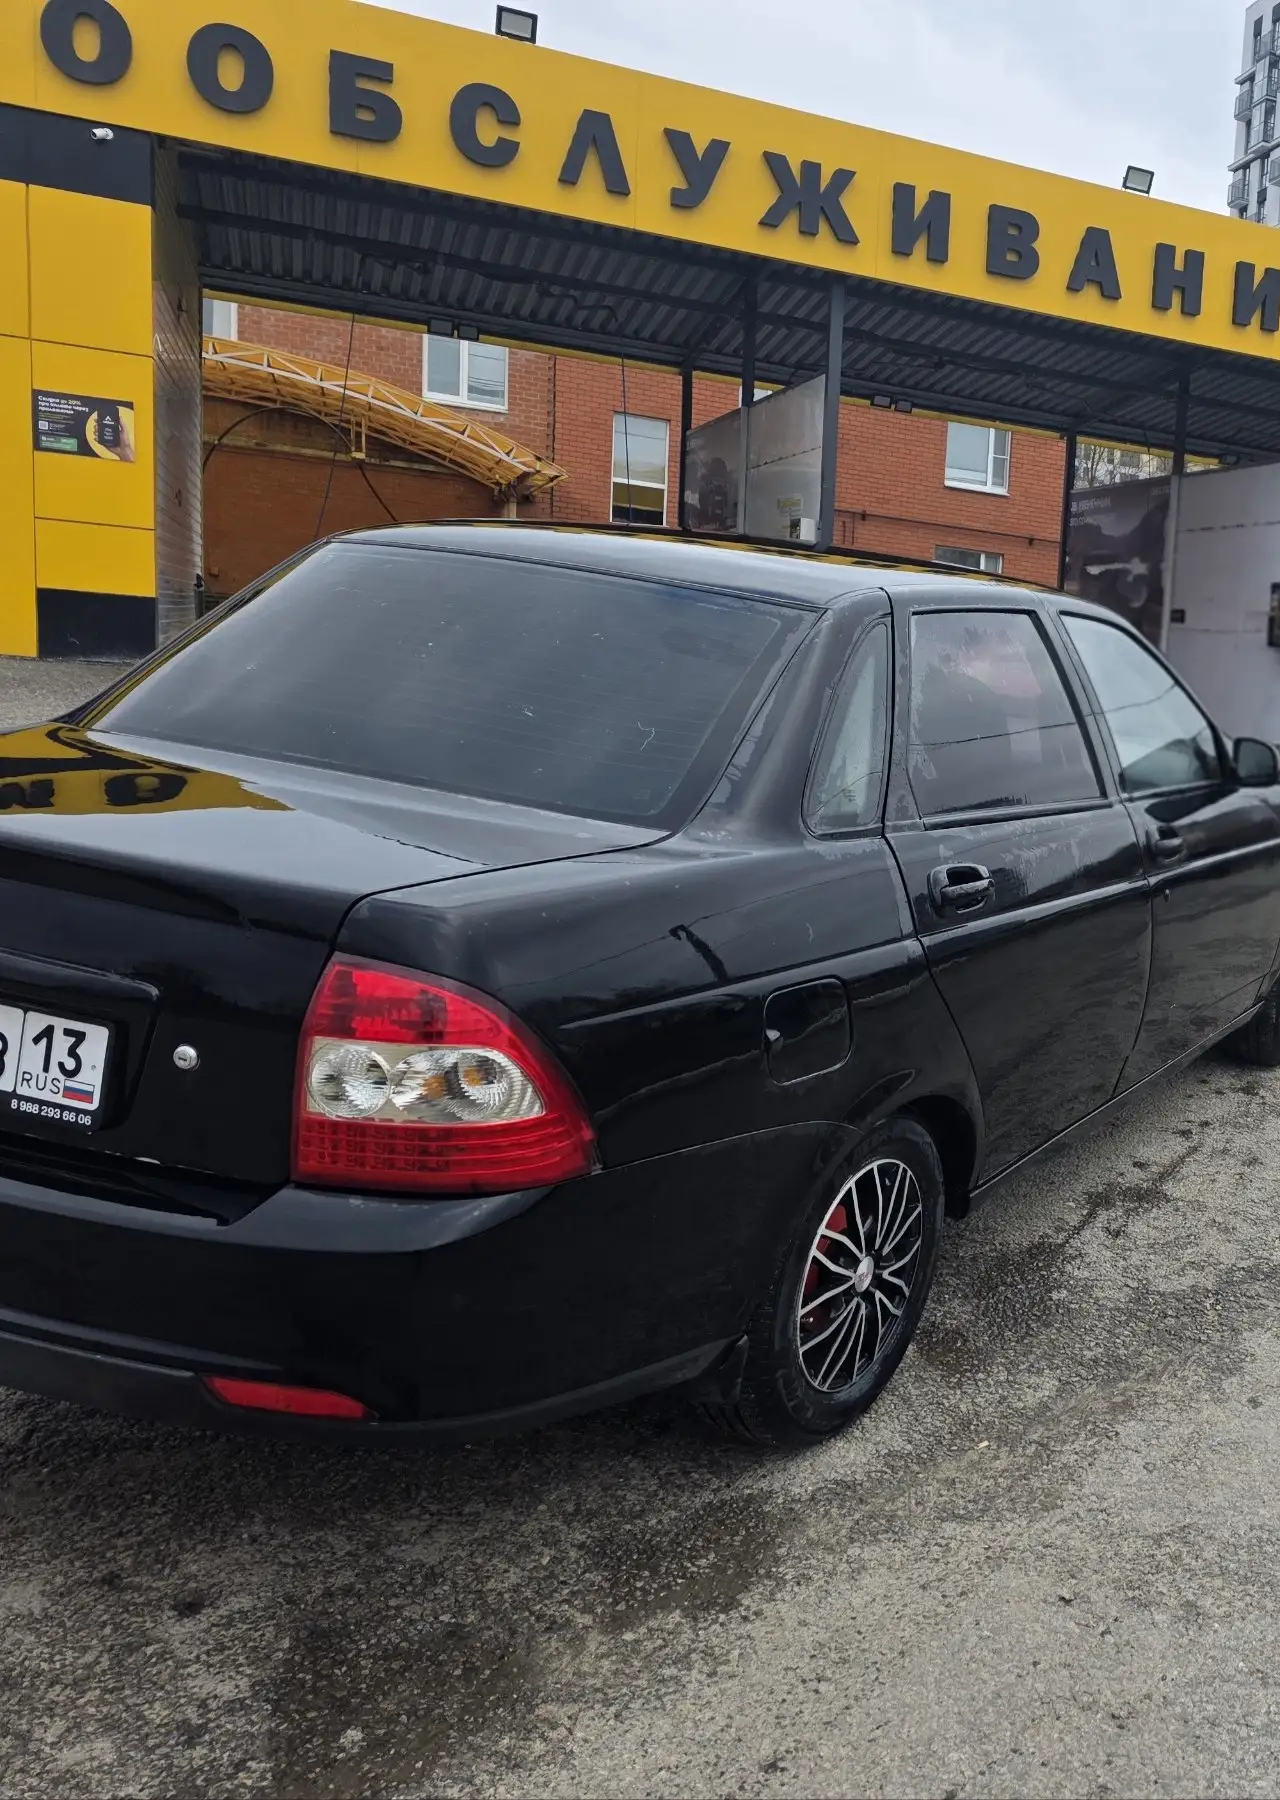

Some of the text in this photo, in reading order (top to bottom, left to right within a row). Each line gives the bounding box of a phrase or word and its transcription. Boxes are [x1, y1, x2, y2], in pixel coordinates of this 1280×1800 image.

[32, 1024, 87, 1078] 13
[20, 1071, 61, 1095] RUS
[10, 1098, 92, 1126] 8 988 293 66 06
